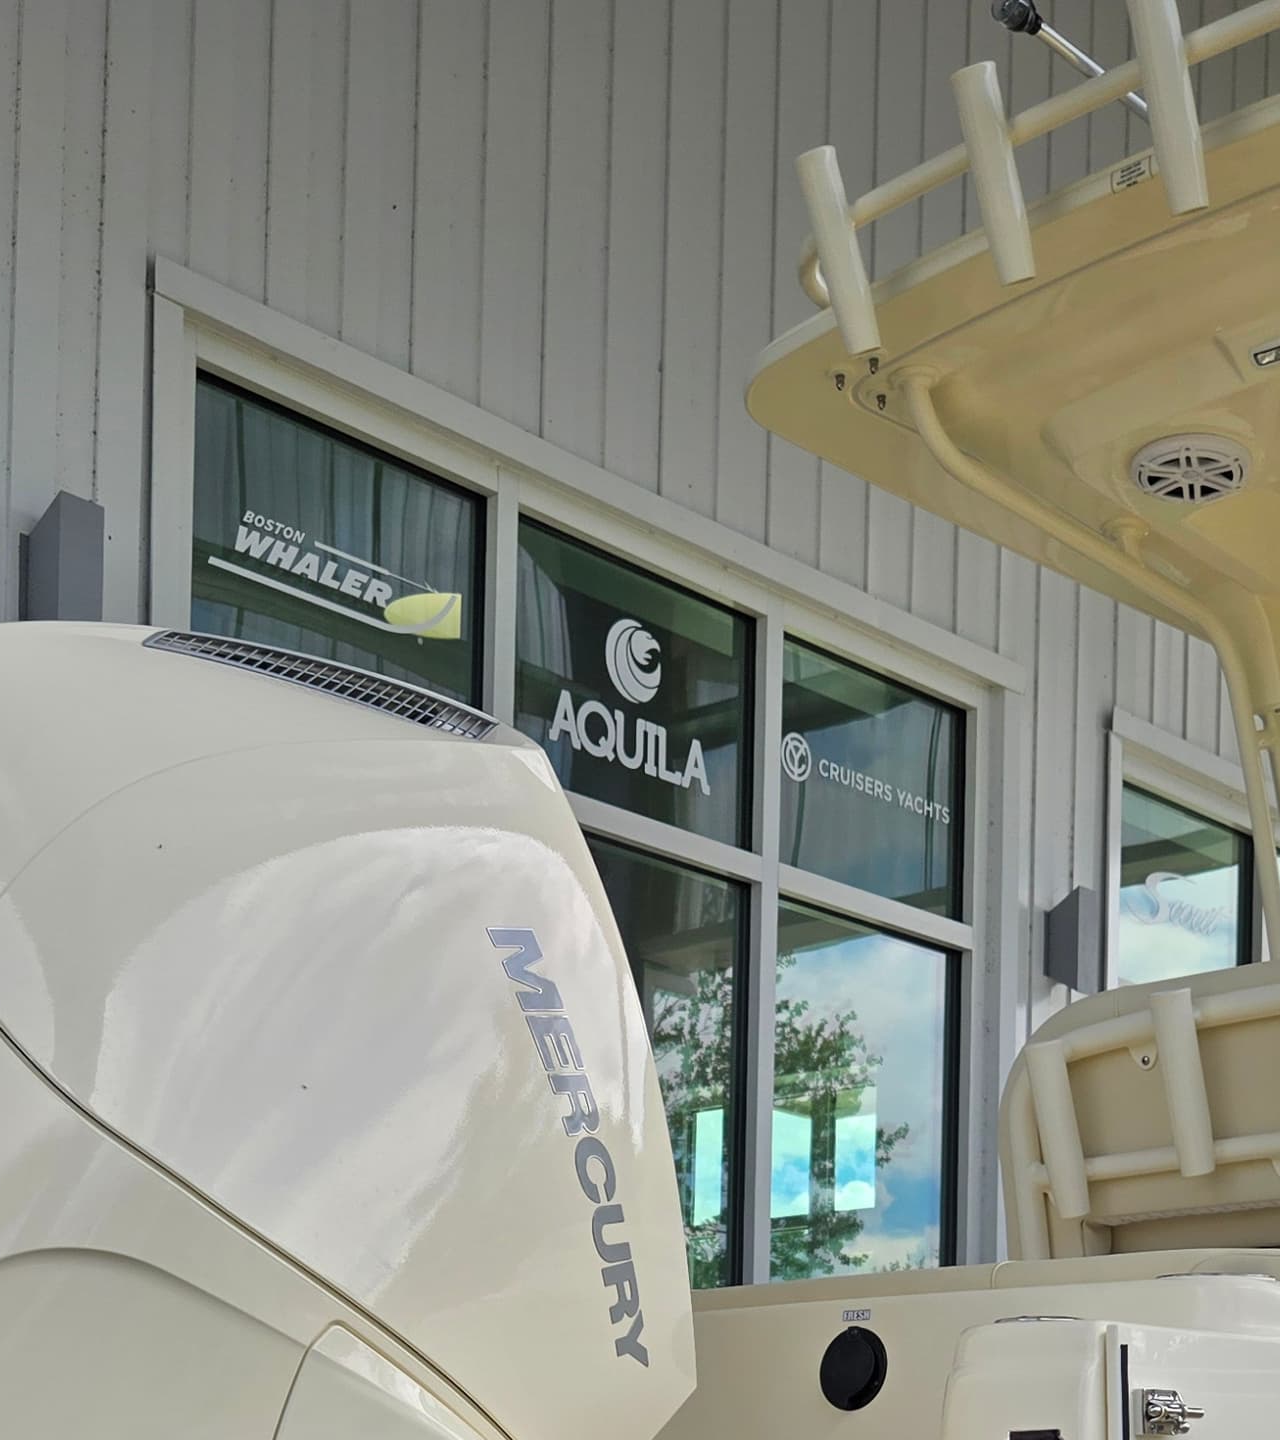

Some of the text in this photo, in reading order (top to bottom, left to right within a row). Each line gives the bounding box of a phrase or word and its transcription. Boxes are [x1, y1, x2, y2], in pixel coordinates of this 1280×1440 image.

[243, 510, 306, 544] BOSTON
[234, 525, 393, 609] WHALER
[549, 689, 710, 796] AQUILA
[819, 759, 951, 825] CRUISERS YACHTS
[486, 927, 649, 1367] MERCURY
[843, 1310, 870, 1321] FRESH
